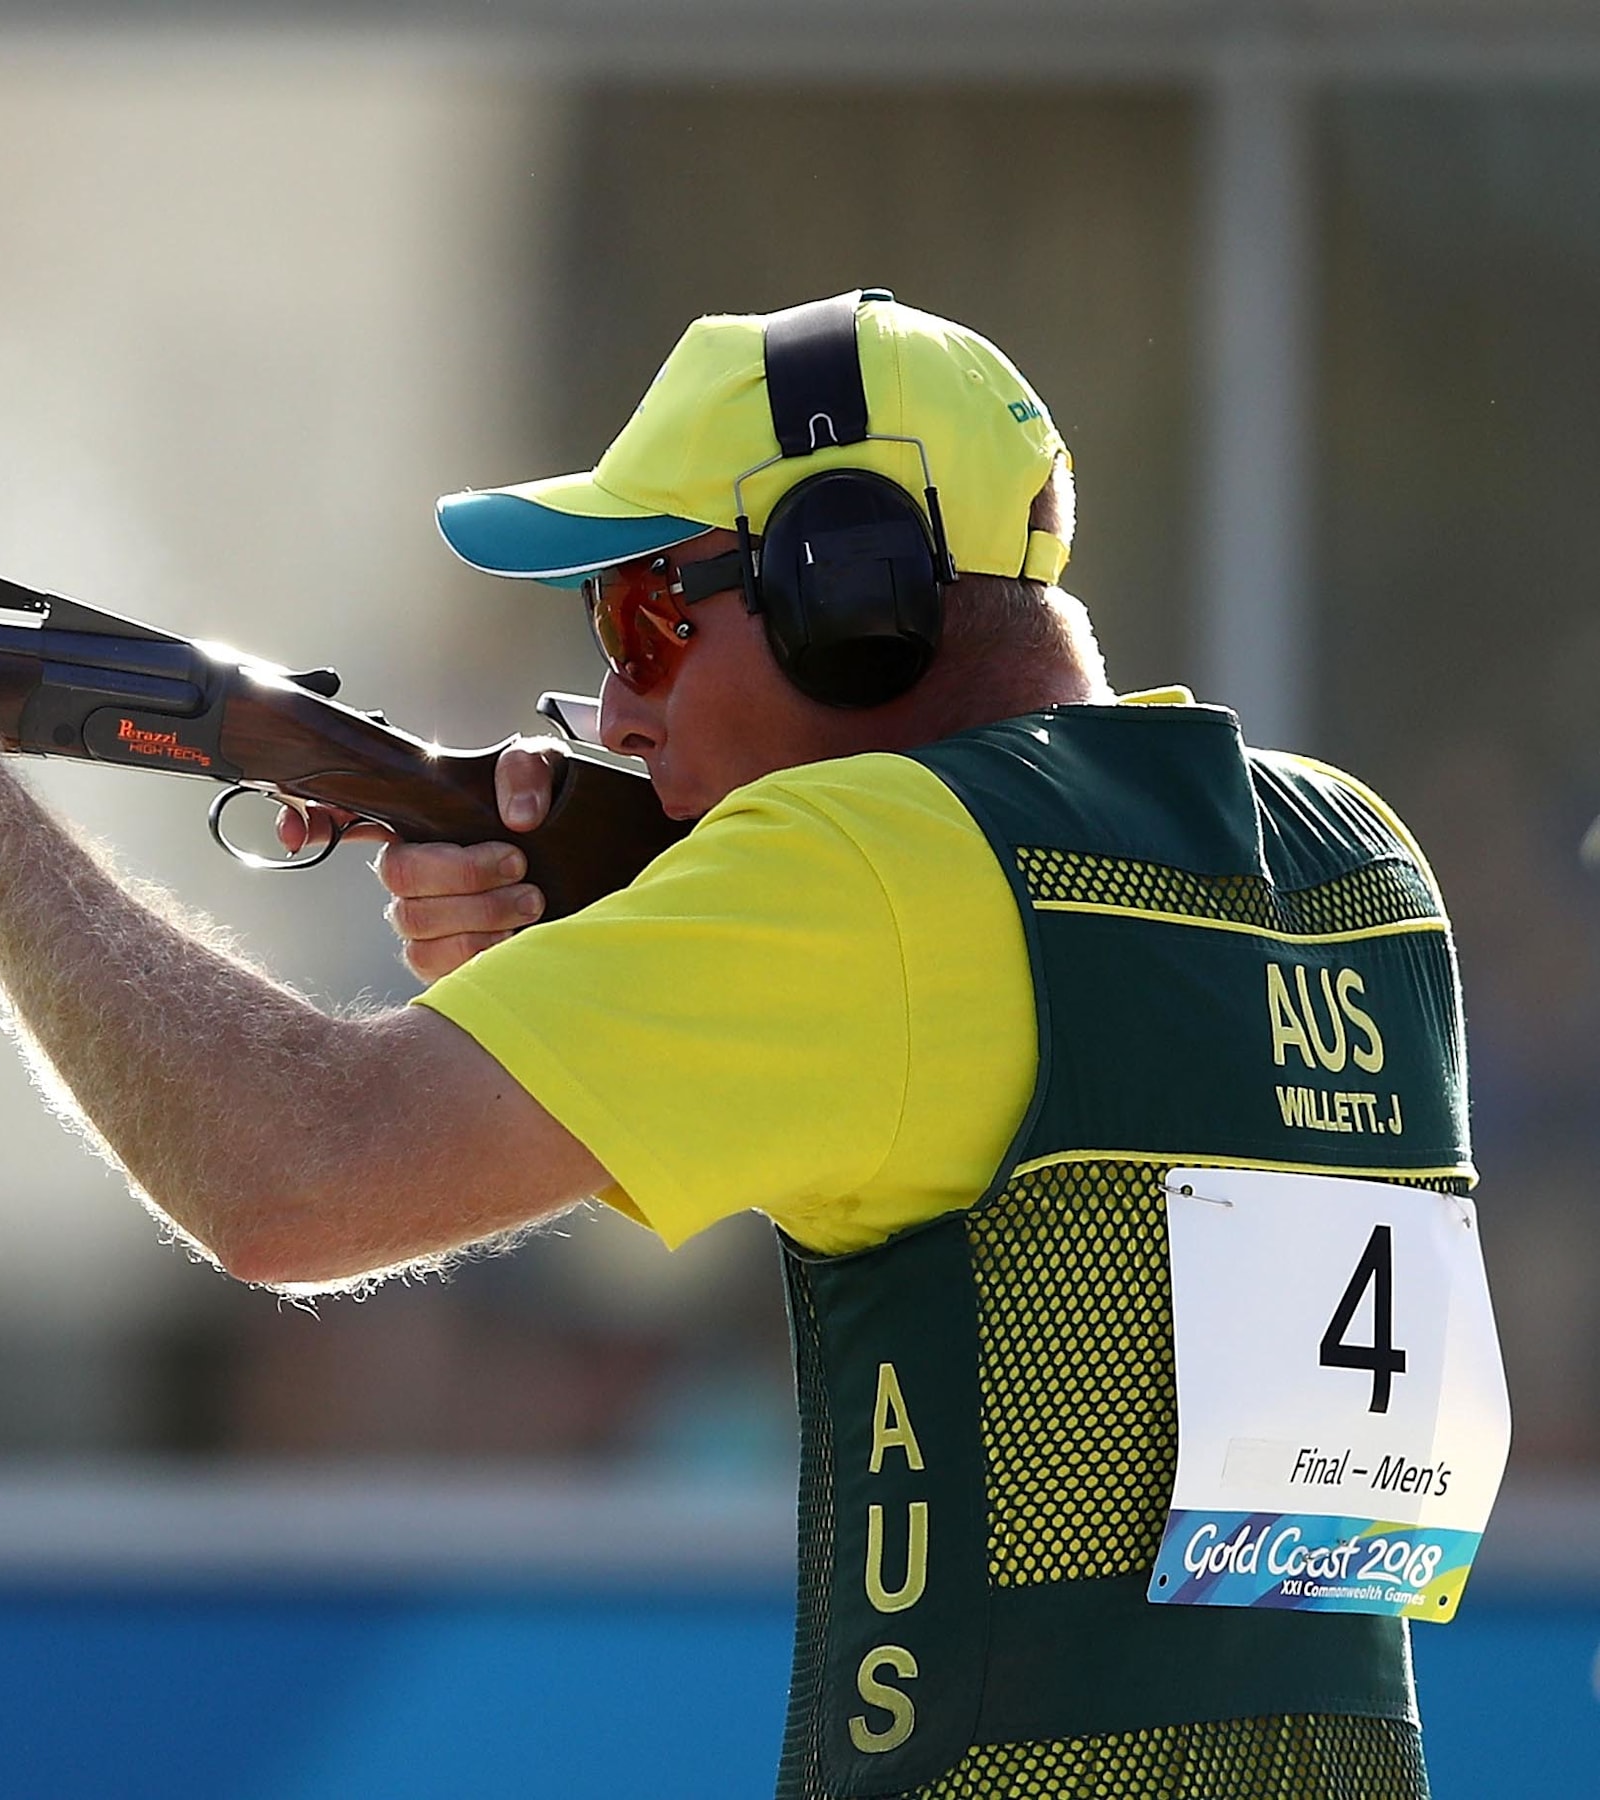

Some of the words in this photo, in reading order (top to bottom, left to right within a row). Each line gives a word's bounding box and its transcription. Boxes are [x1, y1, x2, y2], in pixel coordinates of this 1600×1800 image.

[118, 719, 177, 744] Perazzi
[129, 744, 163, 756] HIGH
[1267, 963, 1384, 1073] AUS
[1275, 1086, 1385, 1134] WILLETT.
[1388, 1094, 1402, 1135] J
[1319, 1225, 1406, 1413] 4
[1290, 1448, 1350, 1485] Final
[1371, 1456, 1451, 1496] Men's
[849, 1362, 928, 1754] AUS
[1184, 1524, 1269, 1580] Gold
[1268, 1526, 1361, 1579] Coast
[1357, 1540, 1442, 1588] 2018
[1280, 1580, 1301, 1596] XXI
[1303, 1582, 1382, 1600] Commonwealth
[1385, 1588, 1425, 1607] Games
